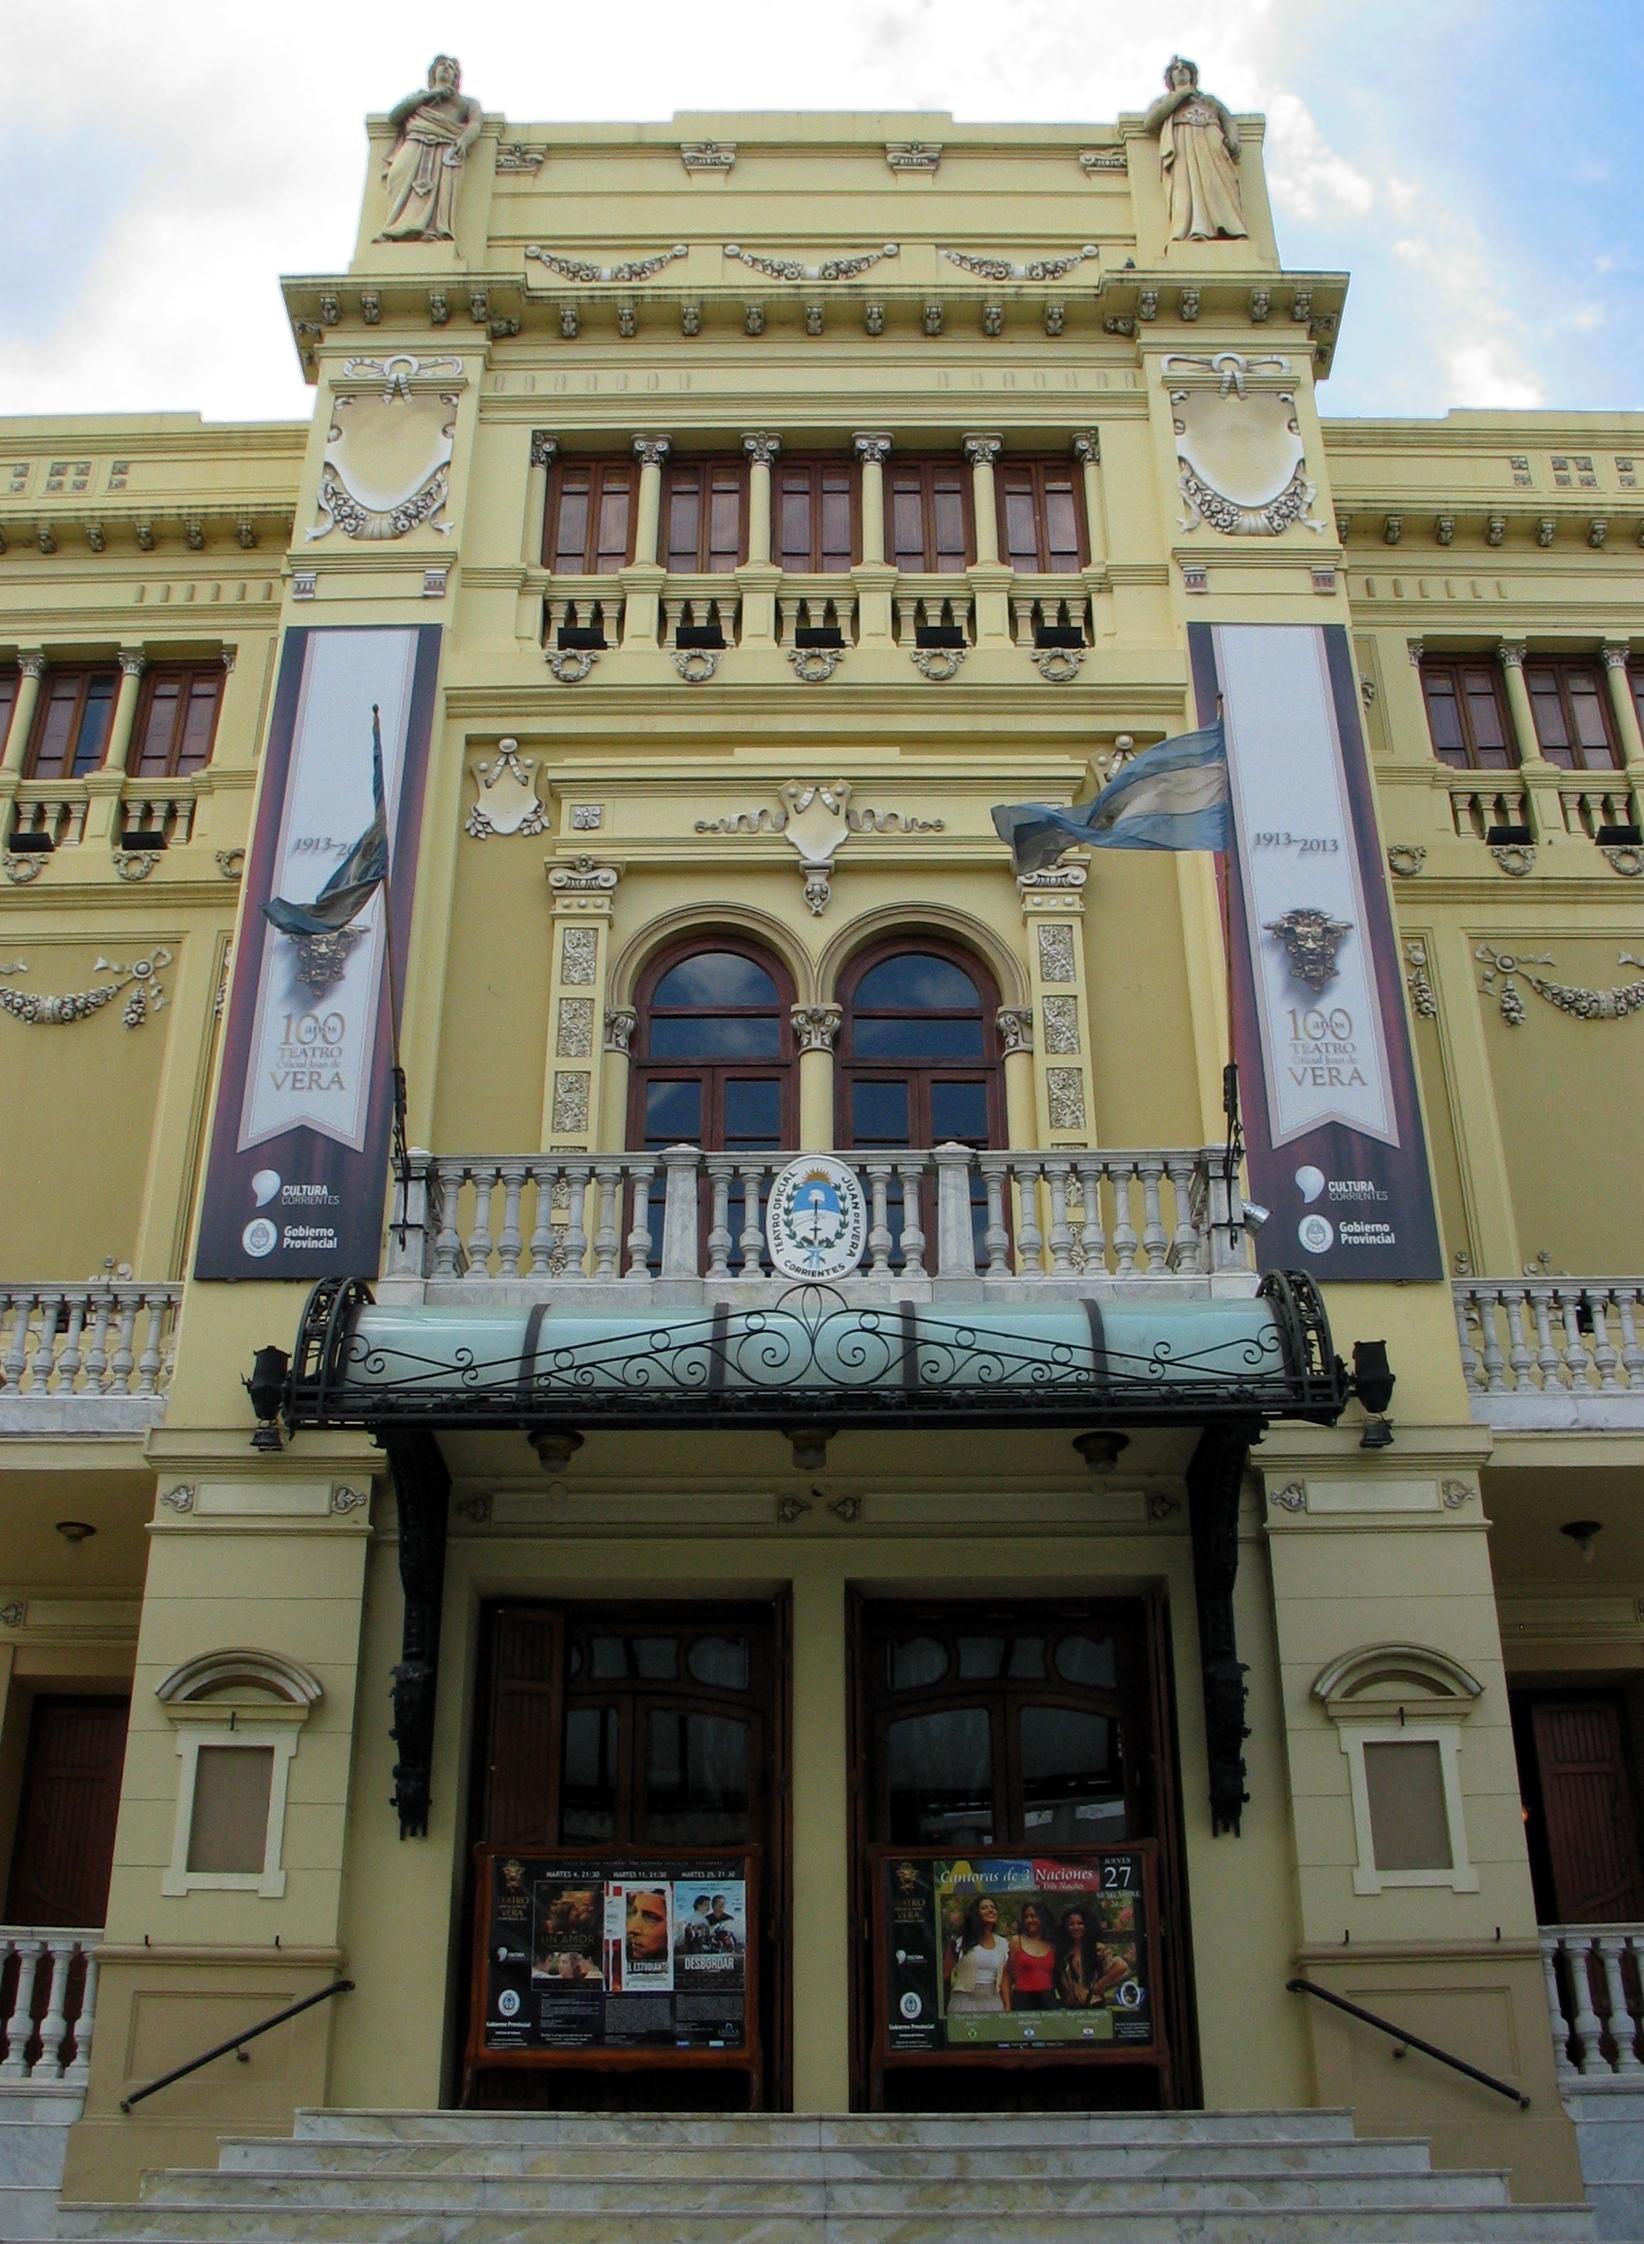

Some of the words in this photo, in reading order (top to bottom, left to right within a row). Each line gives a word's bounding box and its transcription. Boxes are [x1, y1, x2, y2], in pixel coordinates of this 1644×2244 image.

[280, 1012, 344, 1045] 100
[1289, 1008, 1352, 1041] 100
[279, 1046, 343, 1059] TEATRO
[1289, 1042, 1356, 1055] TEATRO
[270, 1070, 346, 1090] VERA
[1288, 1066, 1368, 1086] VERA
[282, 1185, 328, 1196] CULTURA
[773, 1170, 798, 1210] OFICIAL
[841, 1176, 861, 1210] JUAN
[1328, 1181, 1375, 1192] CULTURA
[281, 1194, 340, 1205] CORRIENTES
[1329, 1190, 1389, 1201] CORRIENTES
[852, 1212, 861, 1225] DE
[284, 1225, 334, 1238] Gobierno
[771, 1214, 785, 1255] TEATRO
[1339, 1221, 1390, 1234] Gobierno
[282, 1237, 338, 1249] Provincial
[846, 1226, 861, 1258] VERA
[1341, 1233, 1395, 1247] Provincial
[784, 1260, 846, 1277] CORRIENTES
[1003, 1866, 1018, 1881] de
[1036, 1867, 1093, 1881] Naciones
[1104, 1866, 1131, 1888] 27
[684, 1957, 734, 1970] DESBORDAR
